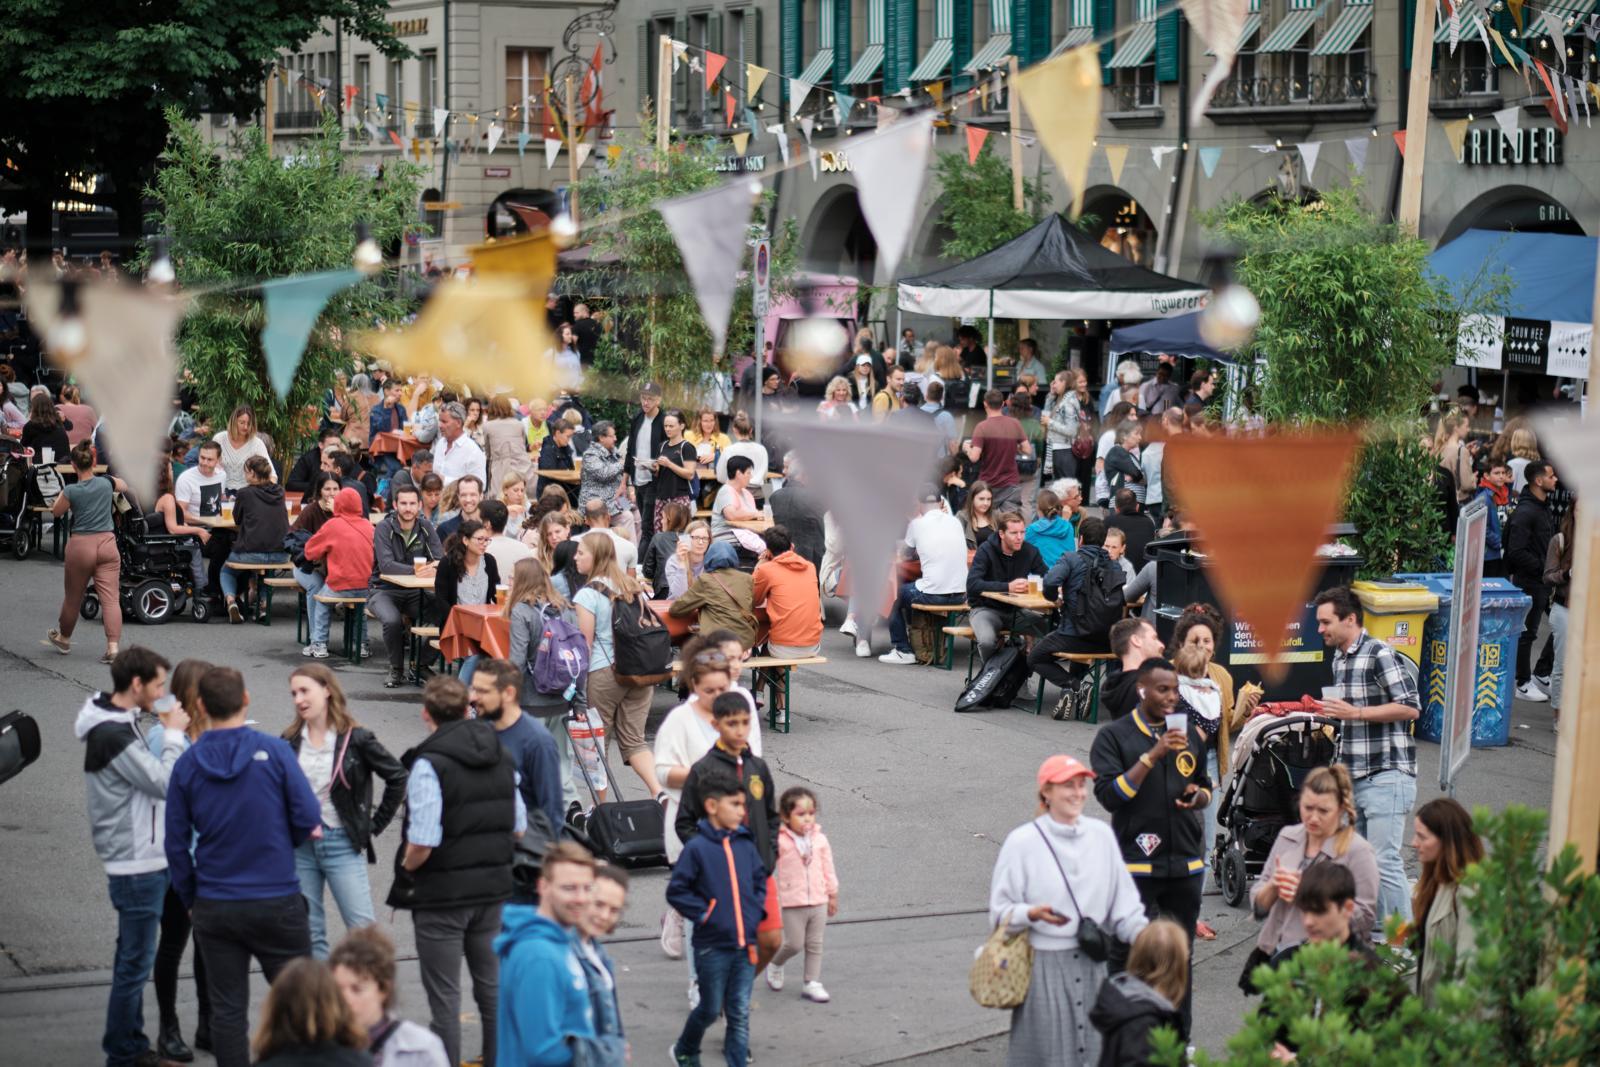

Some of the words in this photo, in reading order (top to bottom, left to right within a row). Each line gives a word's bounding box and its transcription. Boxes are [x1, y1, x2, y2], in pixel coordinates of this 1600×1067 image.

[1234, 622, 1250, 631] Wir
[1234, 630, 1252, 640] den
[1234, 638, 1256, 648] nicht
[973, 670, 996, 691] YONEX
